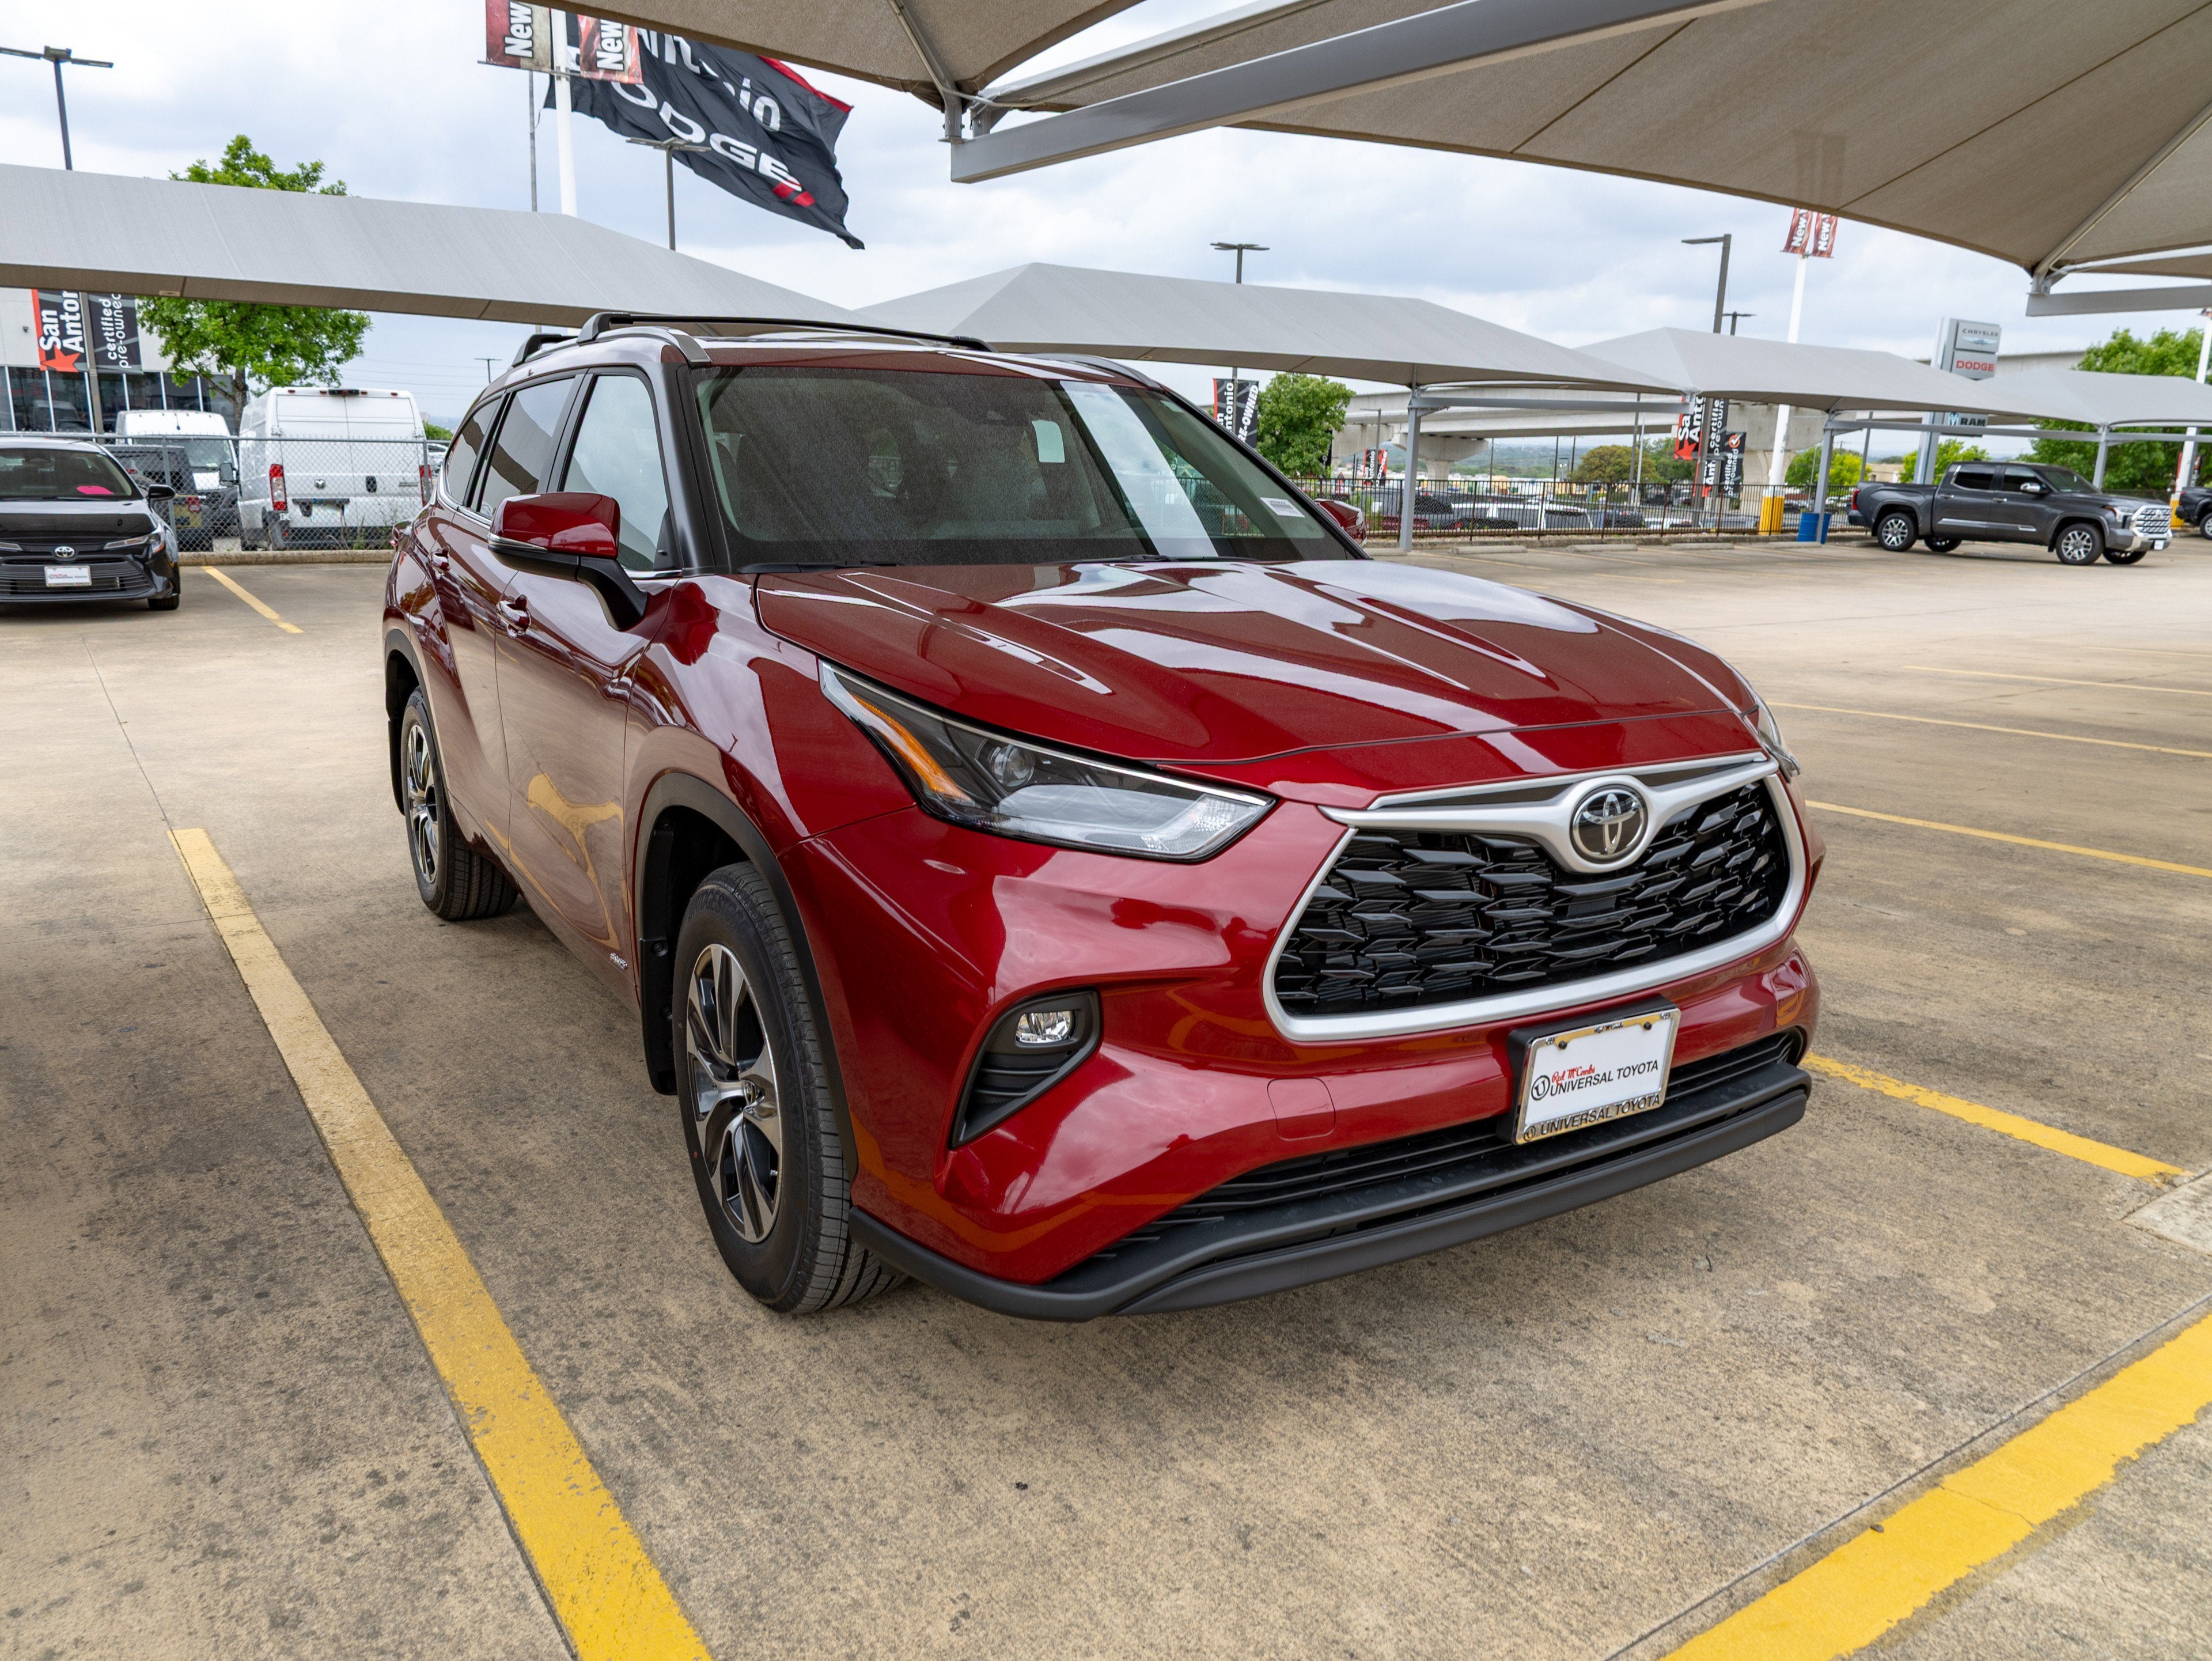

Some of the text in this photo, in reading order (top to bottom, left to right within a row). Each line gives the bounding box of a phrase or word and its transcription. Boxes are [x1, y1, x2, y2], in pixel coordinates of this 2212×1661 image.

[505, 2, 532, 58] New
[596, 19, 624, 70] New
[567, 46, 802, 191] ODGE
[1791, 217, 1807, 247] New
[1818, 222, 1831, 251] New
[38, 309, 62, 351] San
[99, 298, 118, 360] certified
[1963, 328, 1998, 336] CHRYSLER
[1956, 360, 1995, 372] DODGE
[1224, 383, 1234, 432] ntonio
[1237, 385, 1258, 442] RE-OWNED
[1678, 415, 1691, 441] Sa
[1710, 399, 1719, 448] certifie
[1960, 417, 1986, 426] RAM
[1550, 1060, 1658, 1096] UNIVERSAL TOYOTA
[1552, 1070, 1566, 1085] Red
[1541, 1093, 1660, 1135] UNIVERSAL TOYOTA
